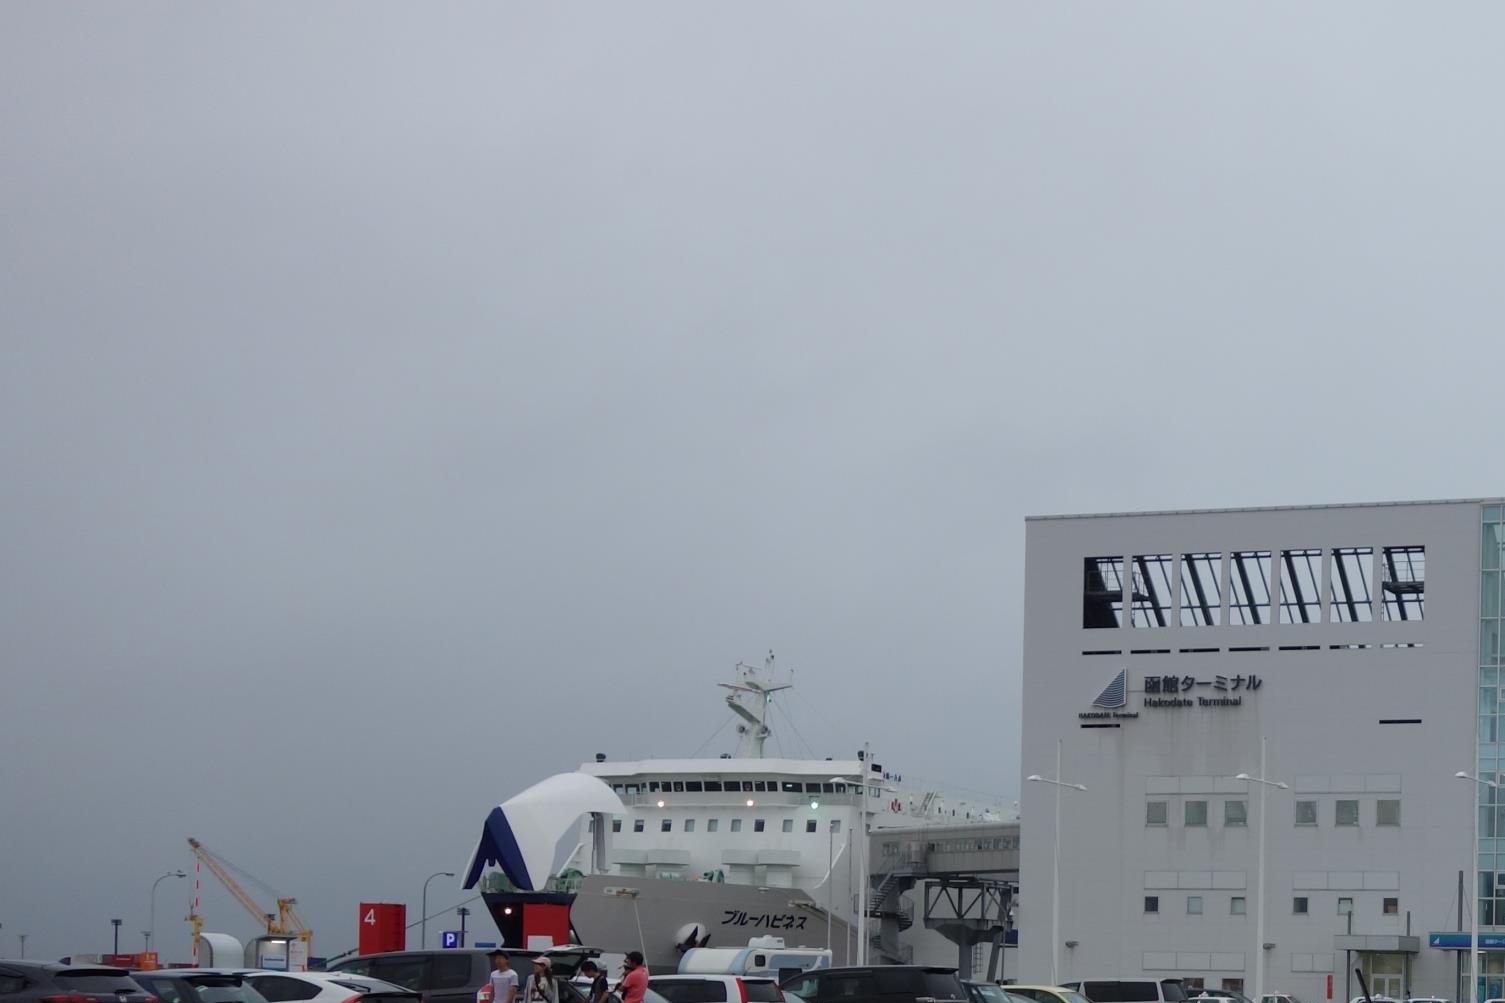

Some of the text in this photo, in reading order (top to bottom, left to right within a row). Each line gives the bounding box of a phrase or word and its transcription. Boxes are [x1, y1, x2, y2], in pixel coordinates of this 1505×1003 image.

[1144, 675, 1262, 693] 函館ターミナル
[1144, 696, 1242, 707] Hakodate Terminal
[364, 908, 376, 926] 4
[721, 910, 807, 930] ブルーハピネス
[446, 933, 456, 946] P
